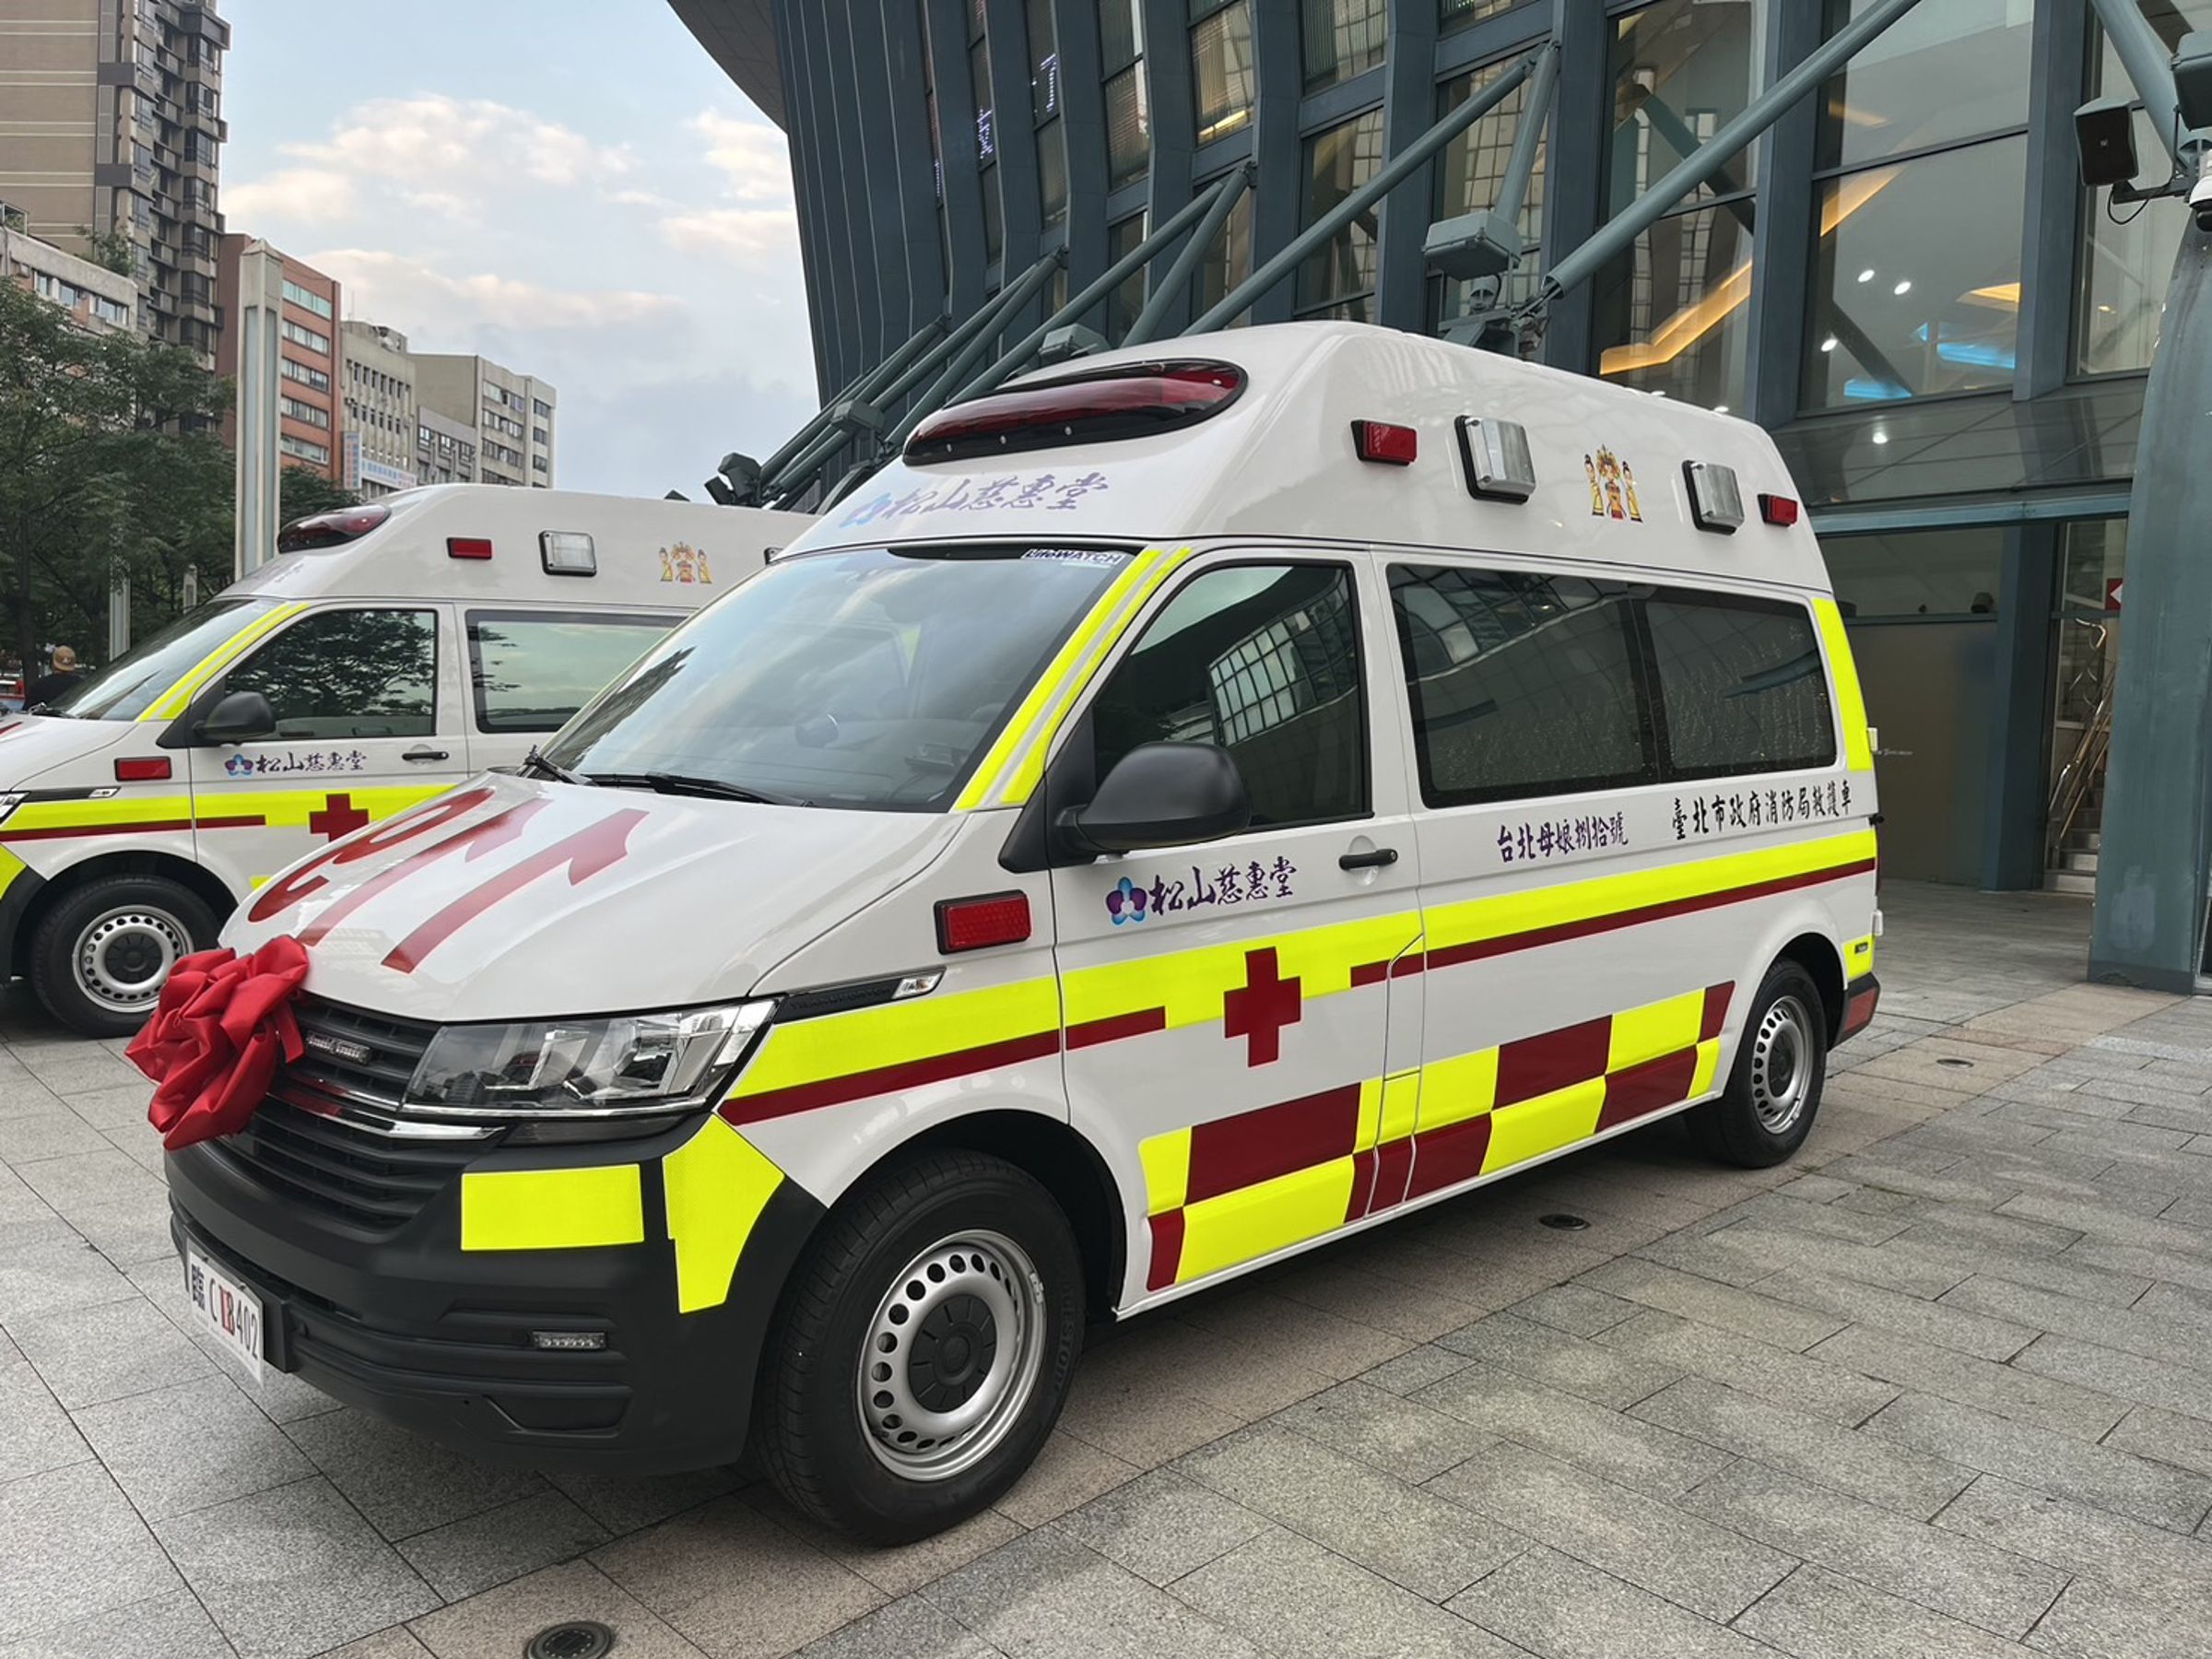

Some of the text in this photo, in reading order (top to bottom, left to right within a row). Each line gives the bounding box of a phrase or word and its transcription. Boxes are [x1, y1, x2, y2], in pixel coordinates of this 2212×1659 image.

[881, 472, 1109, 520] 松山慈惠堂
[255, 741, 367, 773] 松山慈惠堂
[1672, 779, 1852, 841] 臺北市政府消防局救護車
[1149, 856, 1297, 915] 松山慈惠堂
